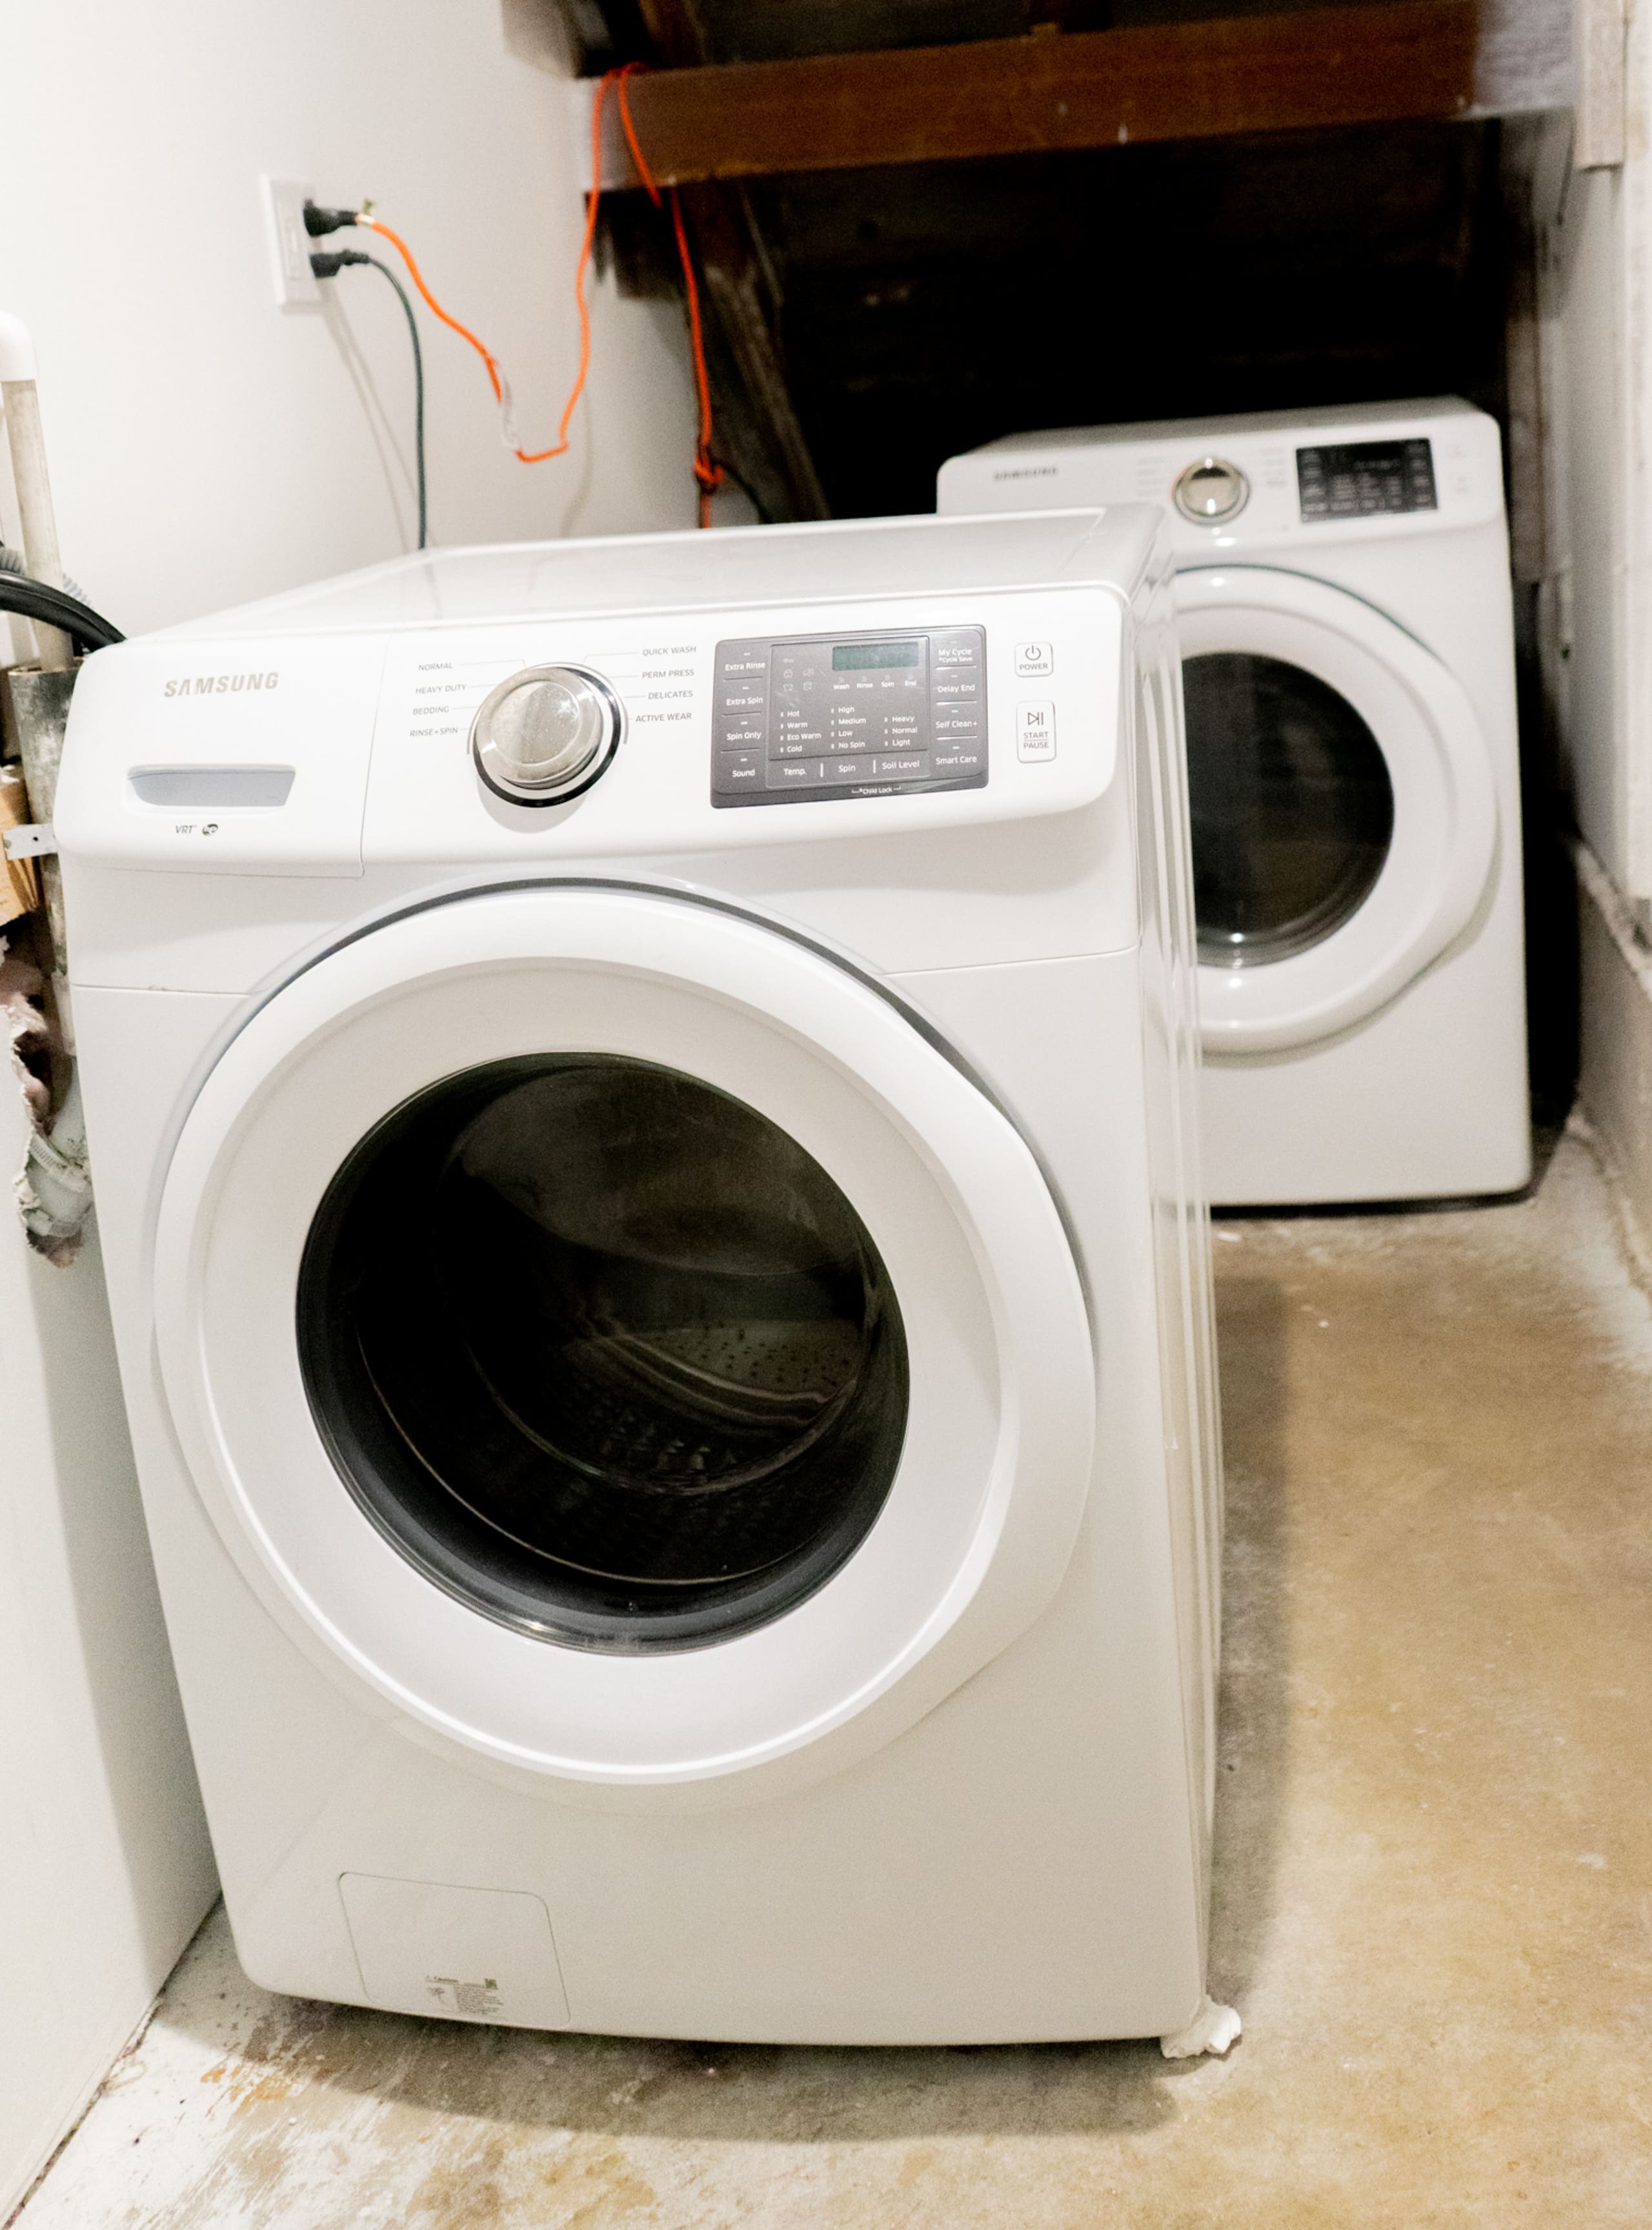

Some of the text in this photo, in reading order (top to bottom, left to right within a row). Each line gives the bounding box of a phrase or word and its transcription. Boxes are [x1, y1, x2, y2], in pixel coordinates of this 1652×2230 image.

[642, 646, 696, 656] QUICK WASH
[418, 662, 453, 671] NORMAL
[164, 672, 279, 698] SAMSUNG
[416, 686, 443, 694] HEAVY
[648, 690, 693, 699] DELICATES
[747, 696, 763, 705] Spin
[413, 706, 449, 715] BEDDING
[636, 712, 692, 723] ACTIVE WEAR
[727, 731, 761, 741] Spin Only
[899, 760, 920, 768] Level
[936, 755, 977, 765] Smart Care
[732, 768, 755, 778] Sound
[838, 764, 856, 773] Spin
[176, 825, 193, 834] VRT
